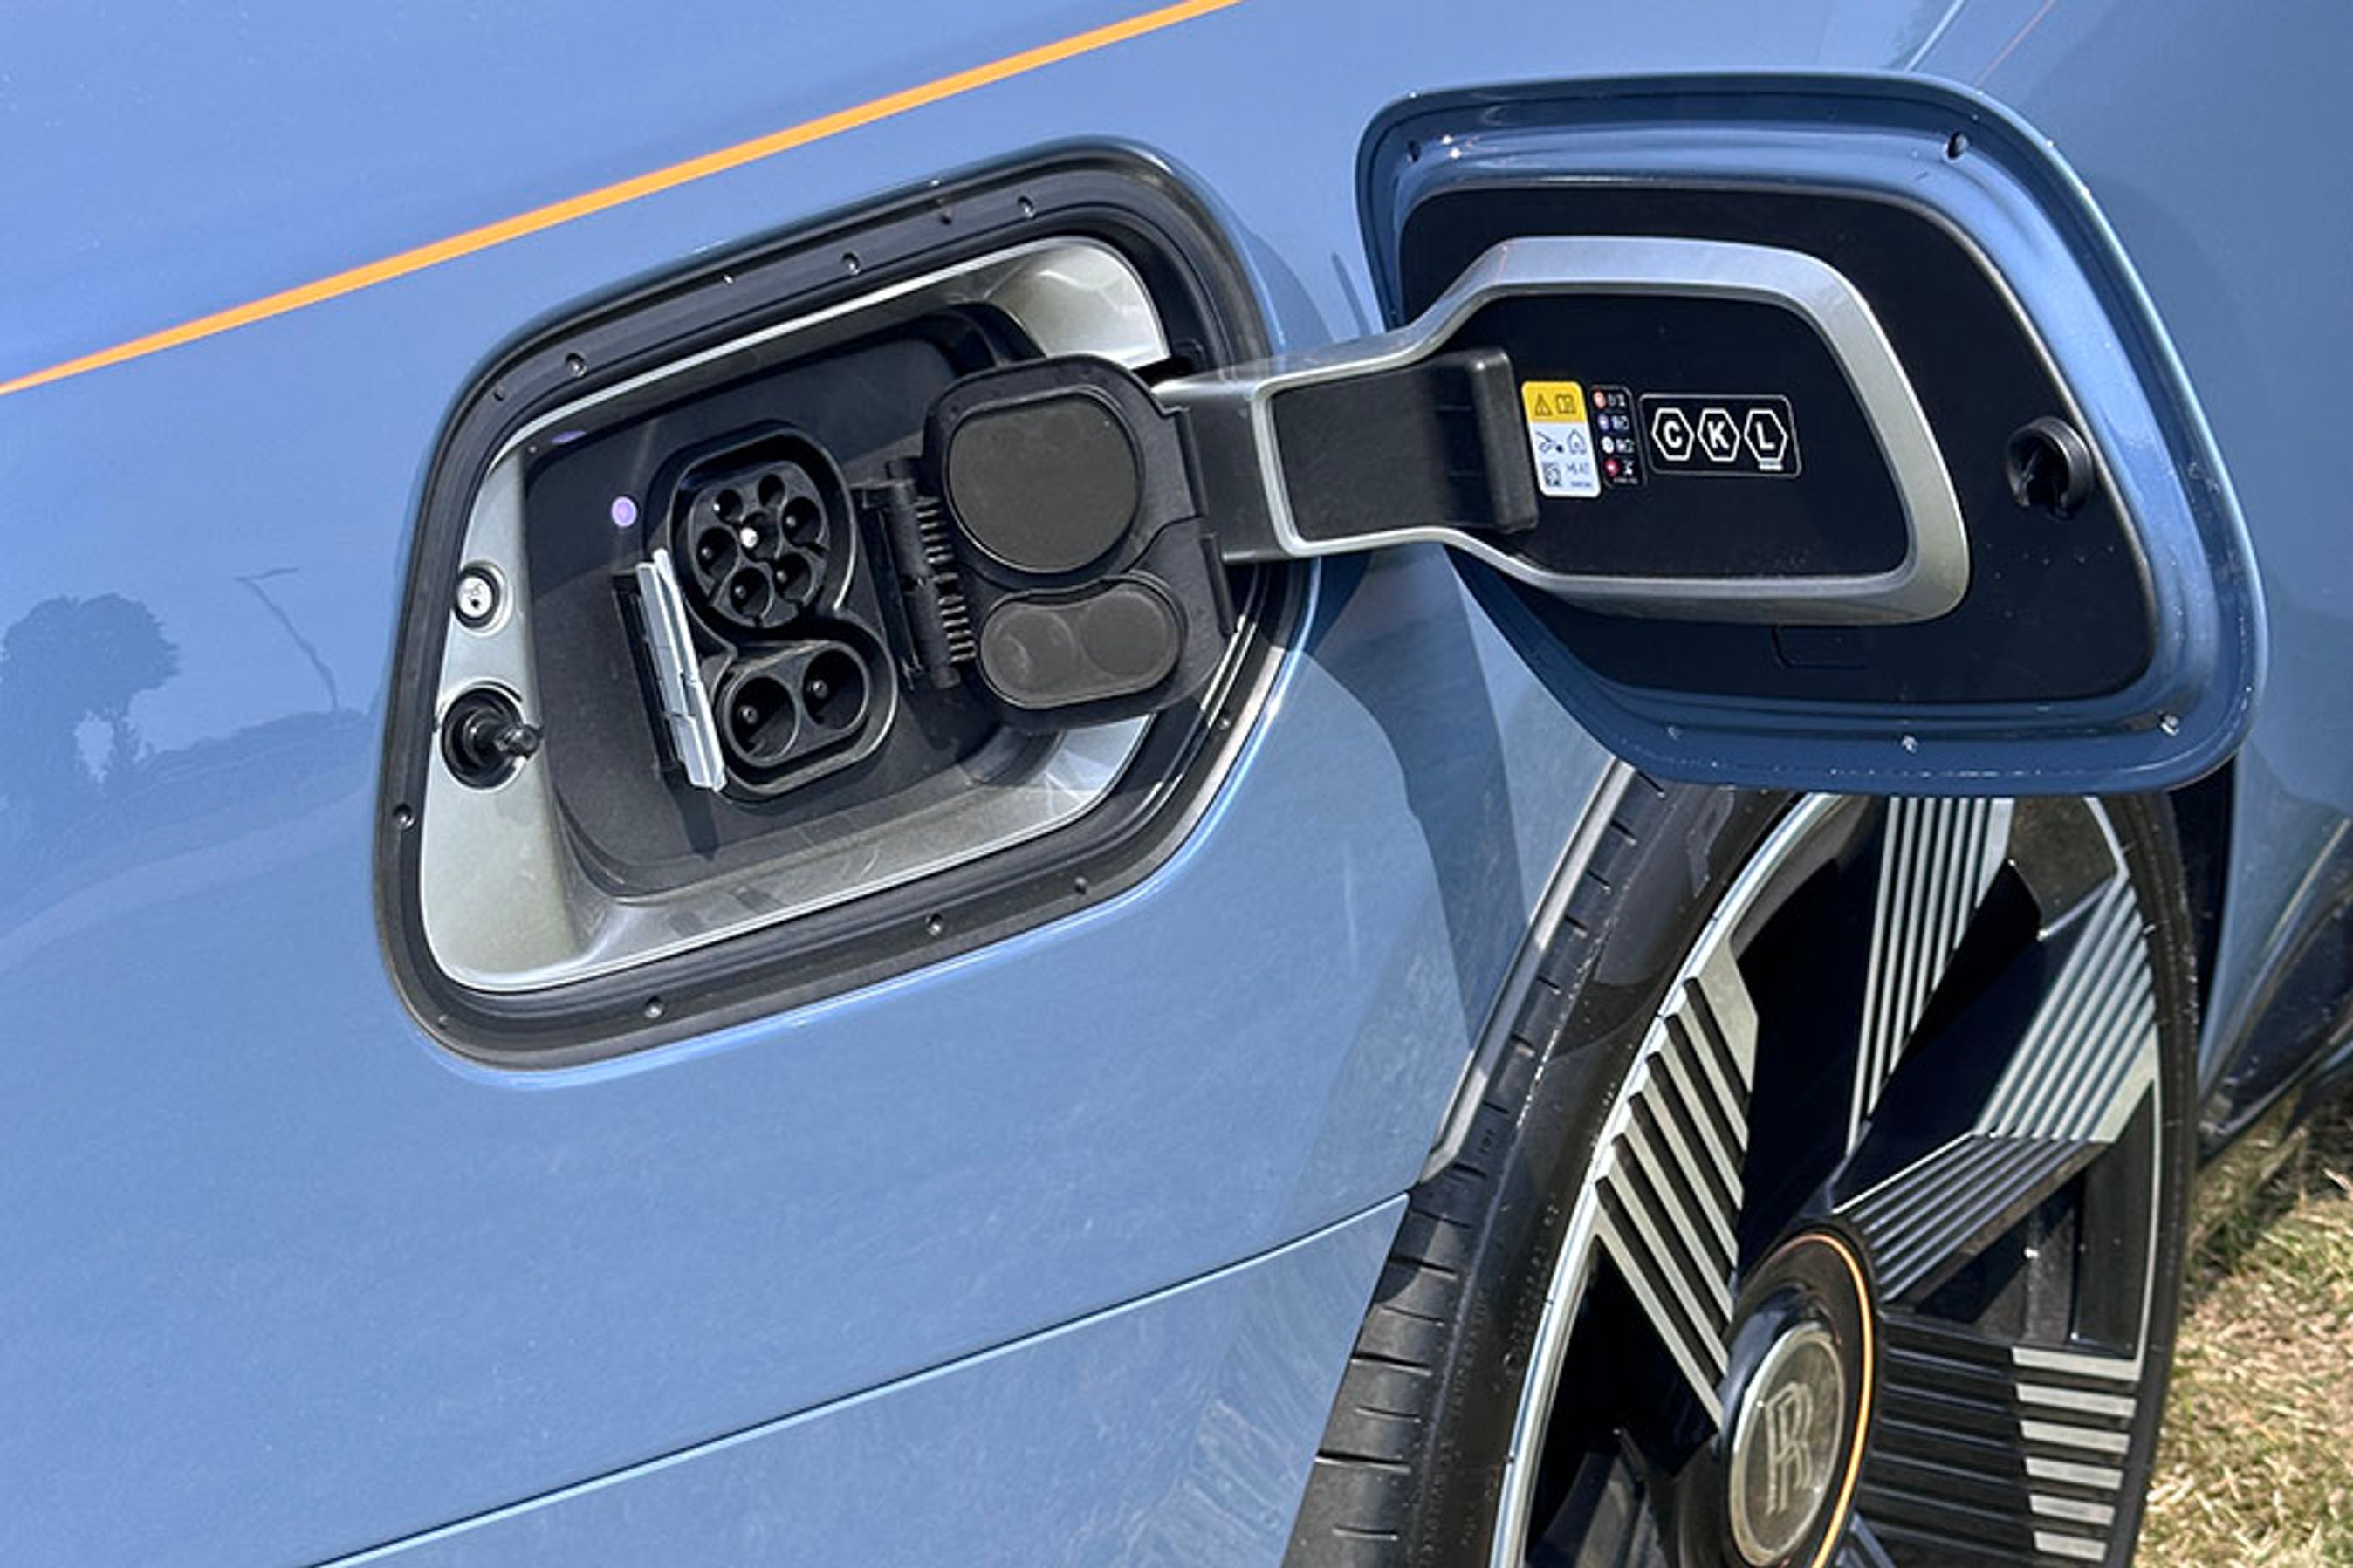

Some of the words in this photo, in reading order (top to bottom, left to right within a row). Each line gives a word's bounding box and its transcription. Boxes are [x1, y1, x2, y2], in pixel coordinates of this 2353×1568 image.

[1663, 421, 1683, 448] C
[1707, 421, 1730, 450] K
[1756, 421, 1775, 450] L
